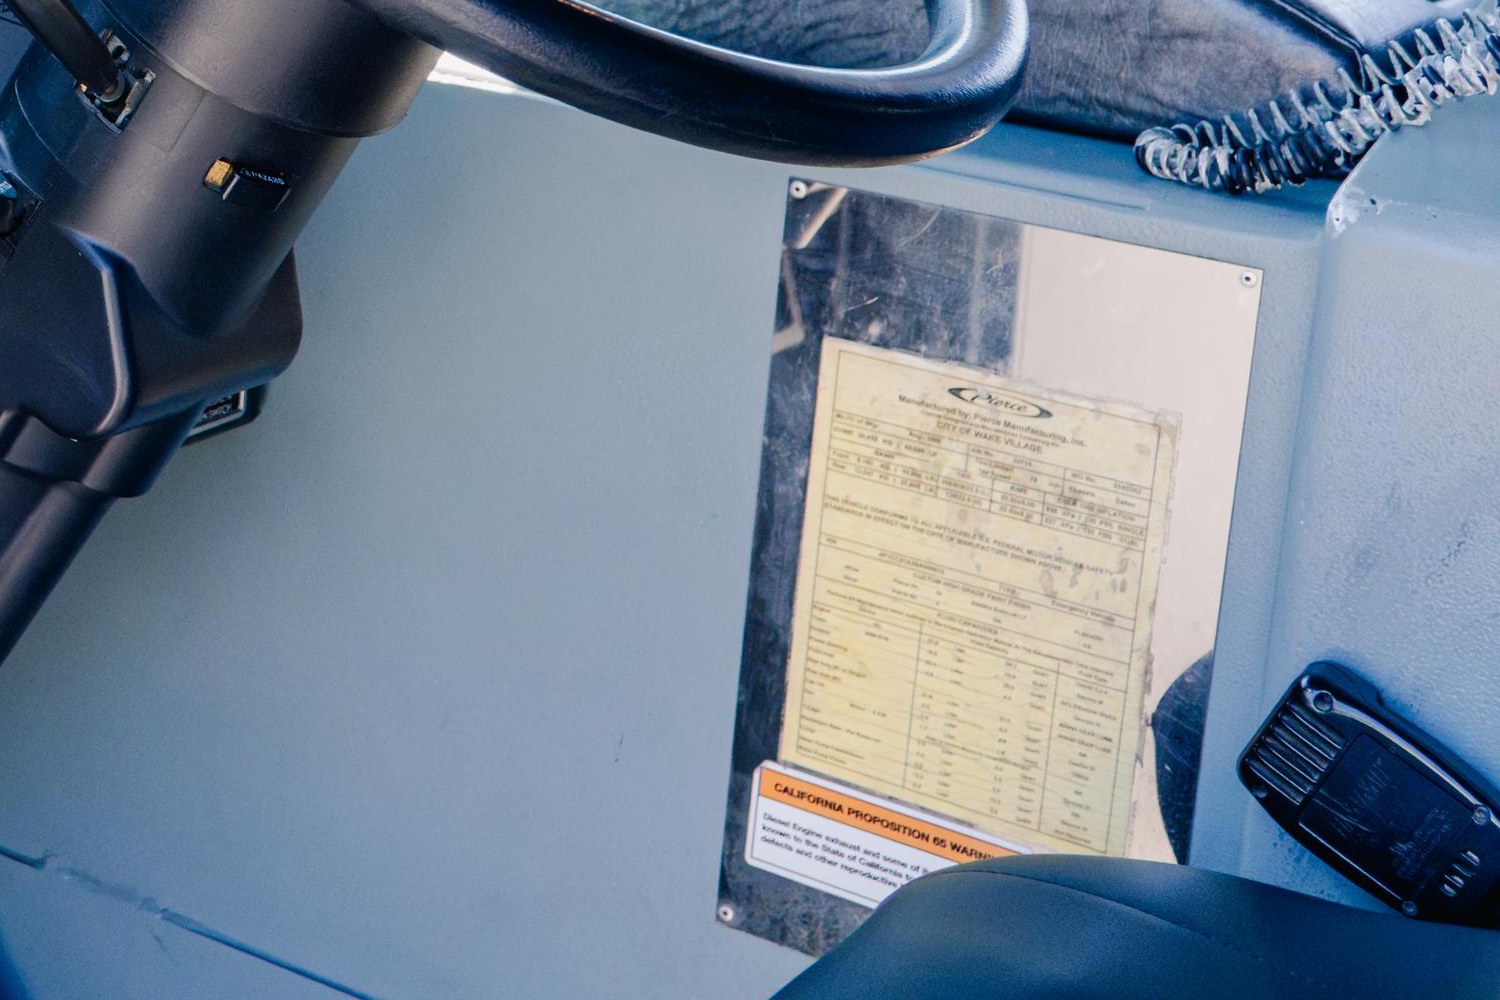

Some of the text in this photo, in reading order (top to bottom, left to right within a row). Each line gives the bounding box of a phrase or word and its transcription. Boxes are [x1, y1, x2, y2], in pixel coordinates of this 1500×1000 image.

[898, 394, 956, 416] Manufactured
[973, 412, 1000, 426] Pierce
[1003, 420, 1068, 444] Manufacturing,
[936, 420, 955, 432] CITY
[959, 426, 970, 436] OF
[974, 430, 999, 443] WAKE
[1003, 437, 1042, 453] VILLAGE
[763, 812, 920, 872] Diesel Engine exhaust and some of
[774, 782, 995, 860] CALIFORNIA PROPOSITION 65 WARN
[760, 836, 898, 887] defects and other reproductive
[762, 824, 791, 840] known
[793, 835, 802, 844] to
[805, 839, 819, 849] the
[821, 844, 844, 858] State
[847, 854, 857, 862] of
[859, 857, 903, 878] California
